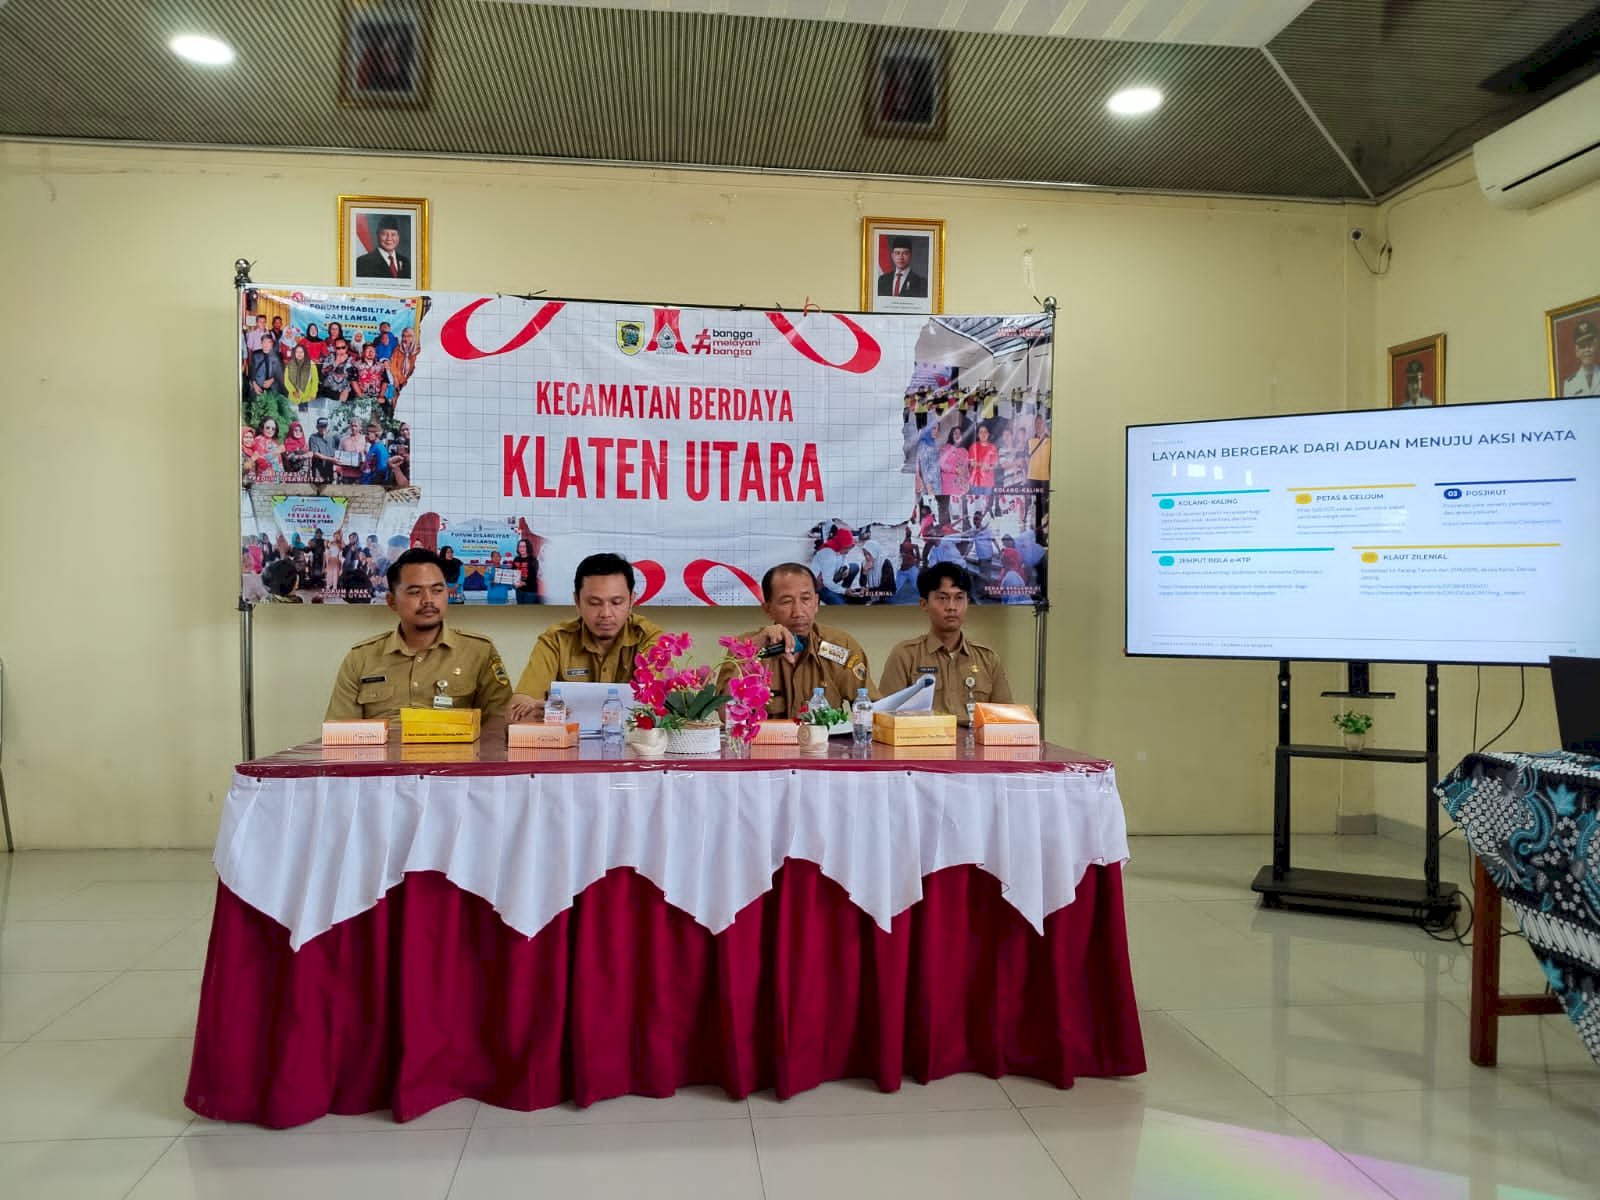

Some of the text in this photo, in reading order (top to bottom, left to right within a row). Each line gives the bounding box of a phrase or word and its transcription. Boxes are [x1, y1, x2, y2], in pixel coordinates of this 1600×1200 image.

[310, 303, 397, 315] FORUM DISABILITAS
[345, 314, 378, 322] LANSIA
[712, 328, 753, 340] bangga
[712, 338, 761, 347] melayani
[712, 348, 752, 358] bangsa
[536, 381, 794, 422] KECAMATAN BERDAYA
[1152, 429, 1577, 462] LAYANAN BERGERAK DARI ADUAN MENUJU AKSI NYATA
[503, 434, 824, 502] KLATEN UTARA
[1411, 553, 1449, 561] ZILENIAL
